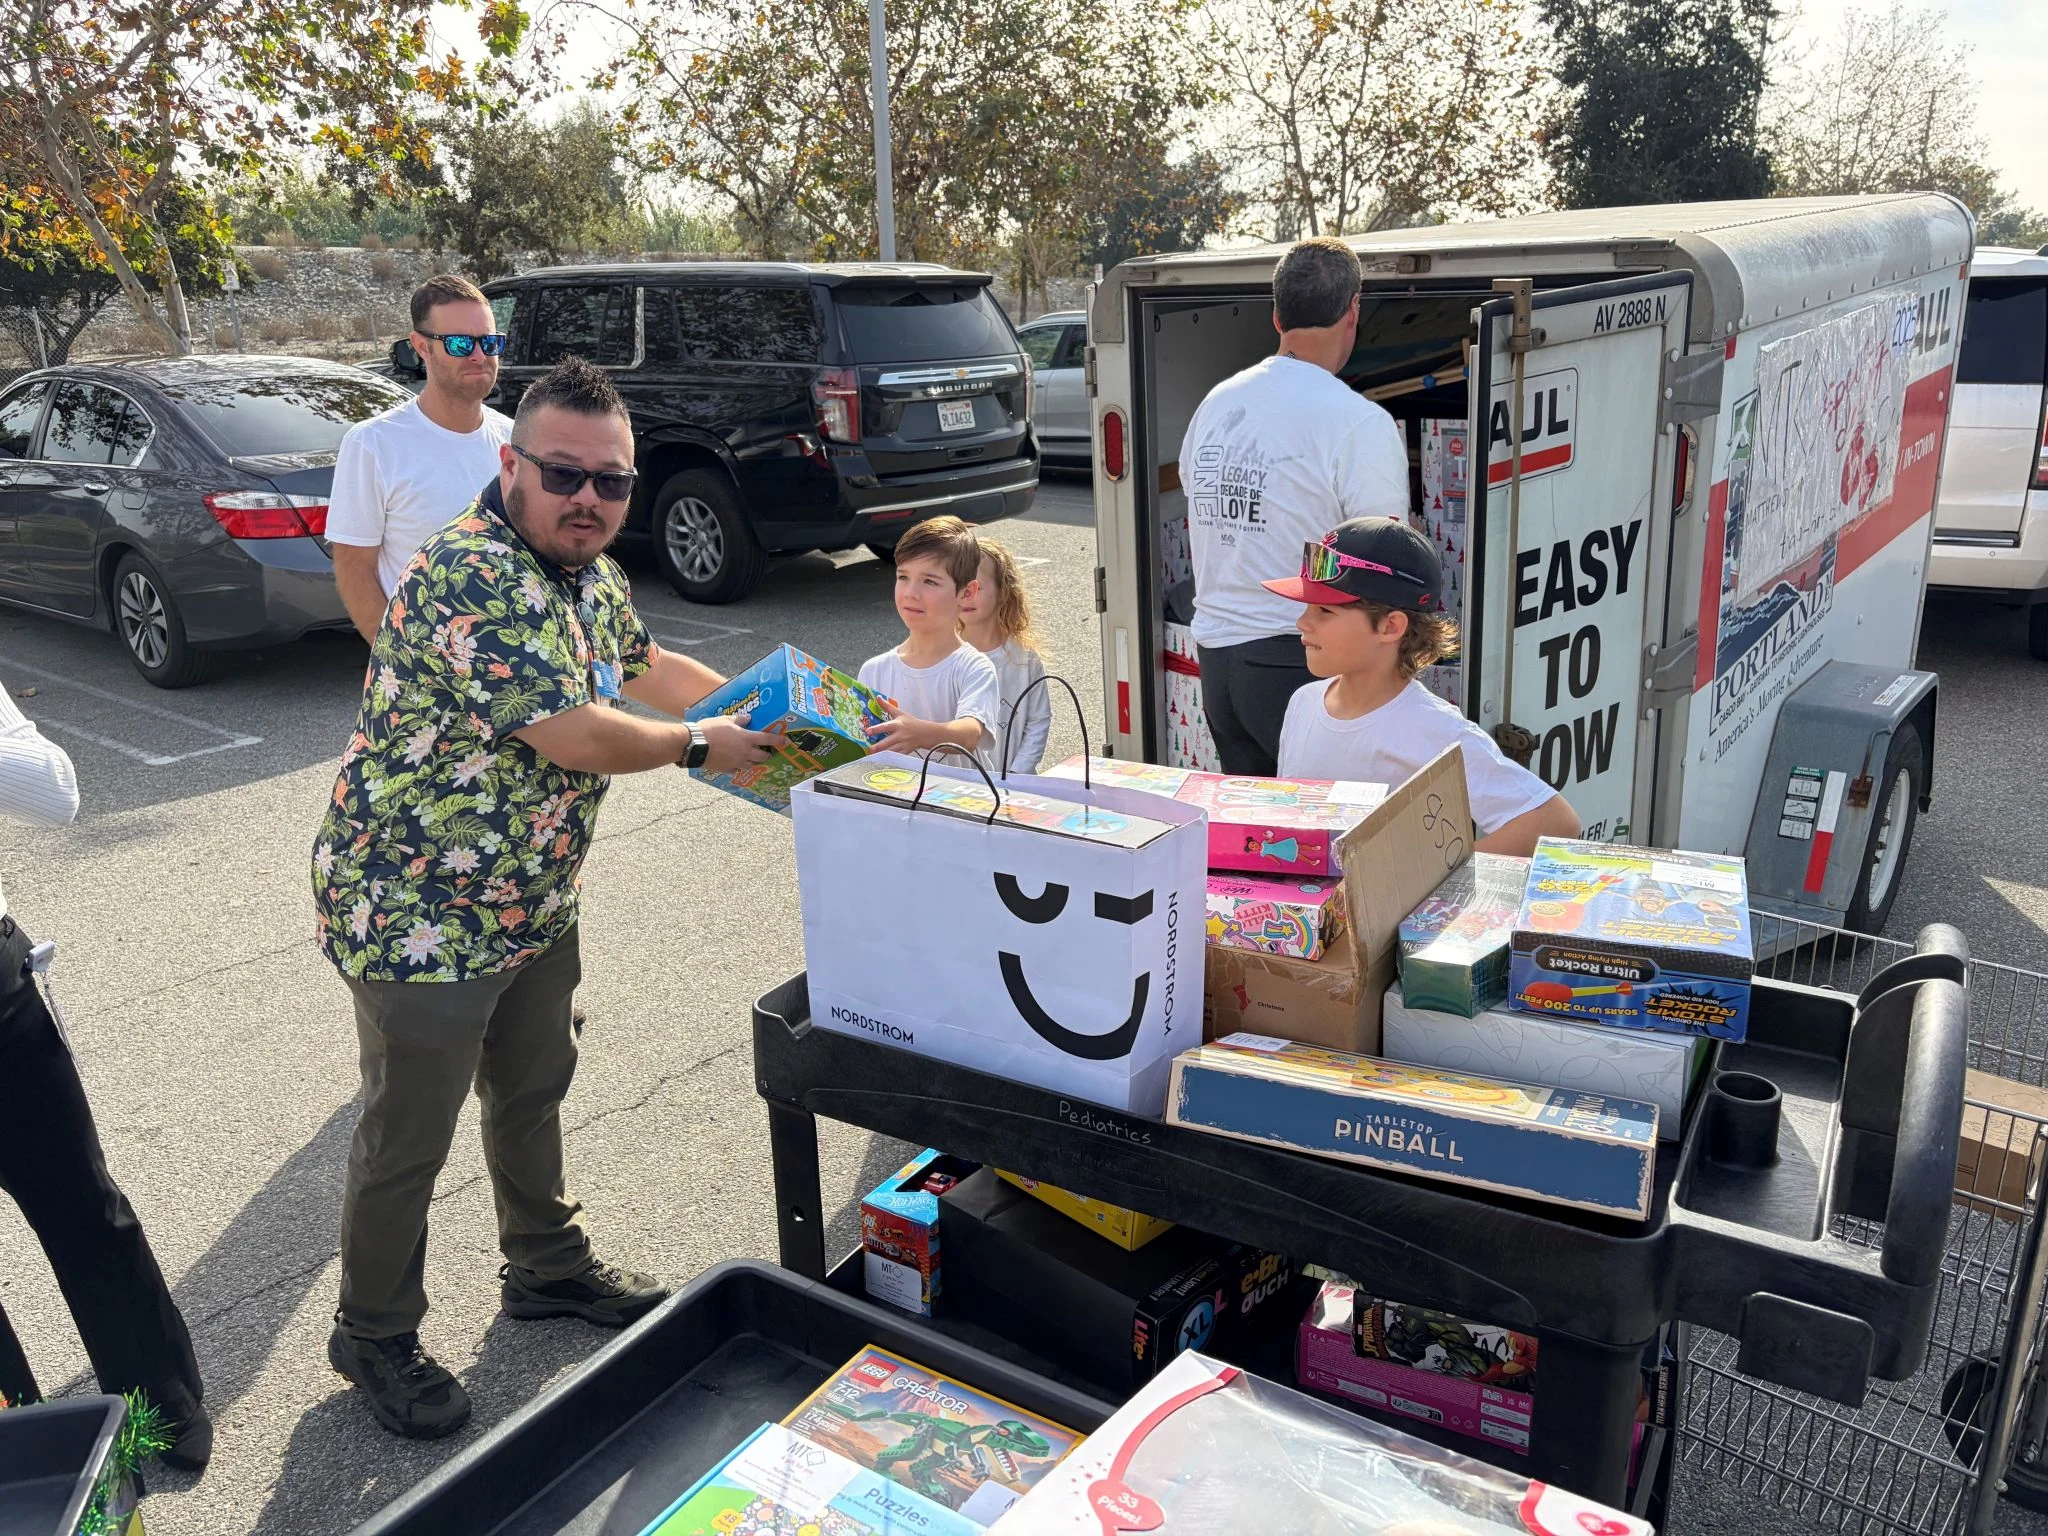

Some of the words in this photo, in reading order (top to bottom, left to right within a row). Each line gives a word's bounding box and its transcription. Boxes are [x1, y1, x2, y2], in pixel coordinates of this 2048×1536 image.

[1594, 304, 1616, 333] AV
[1617, 298, 1651, 328] 2888
[1655, 294, 1667, 321] N
[1892, 304, 1918, 347] 2025
[926, 382, 993, 395] SUBURBAN
[1903, 431, 1936, 470] IN-TOWN
[1193, 446, 1225, 518] ONE
[1221, 465, 1267, 489] LEGACY.
[1220, 484, 1248, 498] DECADE
[1250, 489, 1262, 501] OF
[1221, 497, 1267, 524] LOVE.
[1514, 518, 1642, 628] EASY
[1714, 582, 1824, 717] PORTLAND
[1538, 624, 1601, 710] TO
[1715, 707, 1755, 763] America's
[1757, 678, 1785, 716] Moving
[1787, 634, 1824, 686] Adventure
[1536, 702, 1620, 792] OW
[1536, 881, 1592, 894] 200
[1236, 903, 1271, 920] KITTY
[1600, 921, 1737, 940] ROCKET
[1600, 928, 1725, 945] STOMP
[1164, 891, 1178, 1036] NORDSTROM
[1563, 951, 1586, 961] Action
[1587, 954, 1609, 964] Flying
[1611, 957, 1628, 966] High
[1549, 958, 1600, 975] Rocket
[1601, 964, 1640, 979] Ultra
[1515, 992, 1542, 1004] FEET!
[1659, 992, 1691, 1002] POWERED
[1704, 997, 1720, 1005] 100%
[1257, 1001, 1285, 1012] Christmas
[1544, 1000, 1571, 1012] 200
[1573, 1004, 1587, 1012] TO
[1588, 1006, 1602, 1014] UP
[1605, 1007, 1638, 1016] SOARS
[1643, 997, 1737, 1017] ROCKET
[1646, 1007, 1726, 1024] STOMP
[1661, 1015, 1693, 1026] ORIGINAL
[831, 1006, 914, 1045] NORDSTROM
[1059, 1100, 1152, 1144] Pediatrics
[1366, 1115, 1433, 1135] TABLETOP
[1334, 1118, 1464, 1164] PINBALL
[881, 1262, 892, 1274] MT
[1183, 1312, 1211, 1350] XL
[860, 1364, 892, 1380] LEGO
[1659, 1366, 1669, 1388] SERIES
[832, 1383, 861, 1400] 7-12
[893, 1376, 968, 1415] CREATOR
[1657, 1388, 1667, 1405] HERO
[1655, 1405, 1665, 1425] TITAN
[787, 1441, 812, 1458] MT
[864, 1487, 930, 1528] Puzzles
[1118, 1492, 1139, 1508] 33
